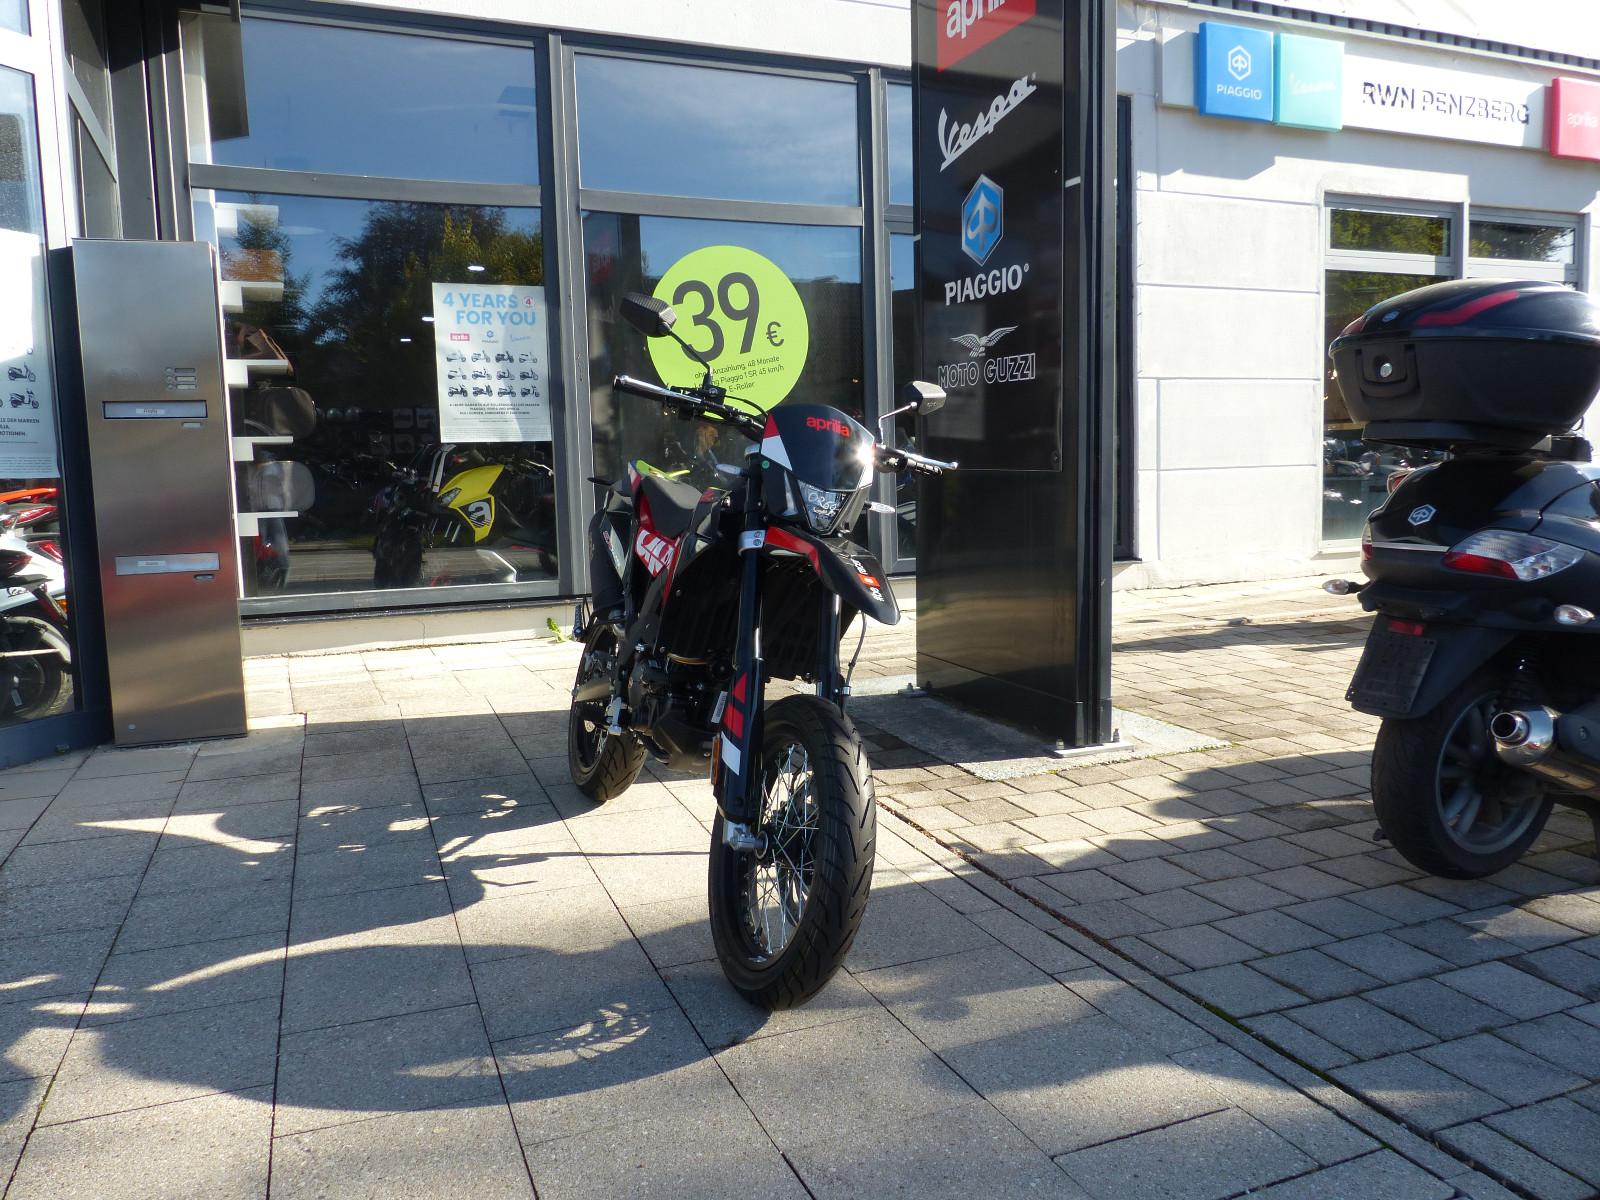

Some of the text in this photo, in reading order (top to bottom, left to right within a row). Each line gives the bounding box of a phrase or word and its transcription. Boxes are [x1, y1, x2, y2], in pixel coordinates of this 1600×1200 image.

[1216, 84, 1262, 100] PIAGGIO
[1363, 81, 1529, 125] RWN PENZBERG
[938, 75, 1037, 173] Vespa
[944, 264, 1023, 306] PIAGGIO
[442, 292, 518, 309] 4 YEARS
[456, 310, 536, 326] FOR YOU
[672, 271, 785, 363] 39 €
[747, 359, 756, 367] 48
[757, 355, 781, 366] Monate
[938, 353, 1036, 389] MOTO GUZZI
[720, 373, 744, 385] Piaggio
[759, 366, 767, 375] 45
[767, 362, 786, 374] km/h
[806, 416, 850, 438] aprilia
